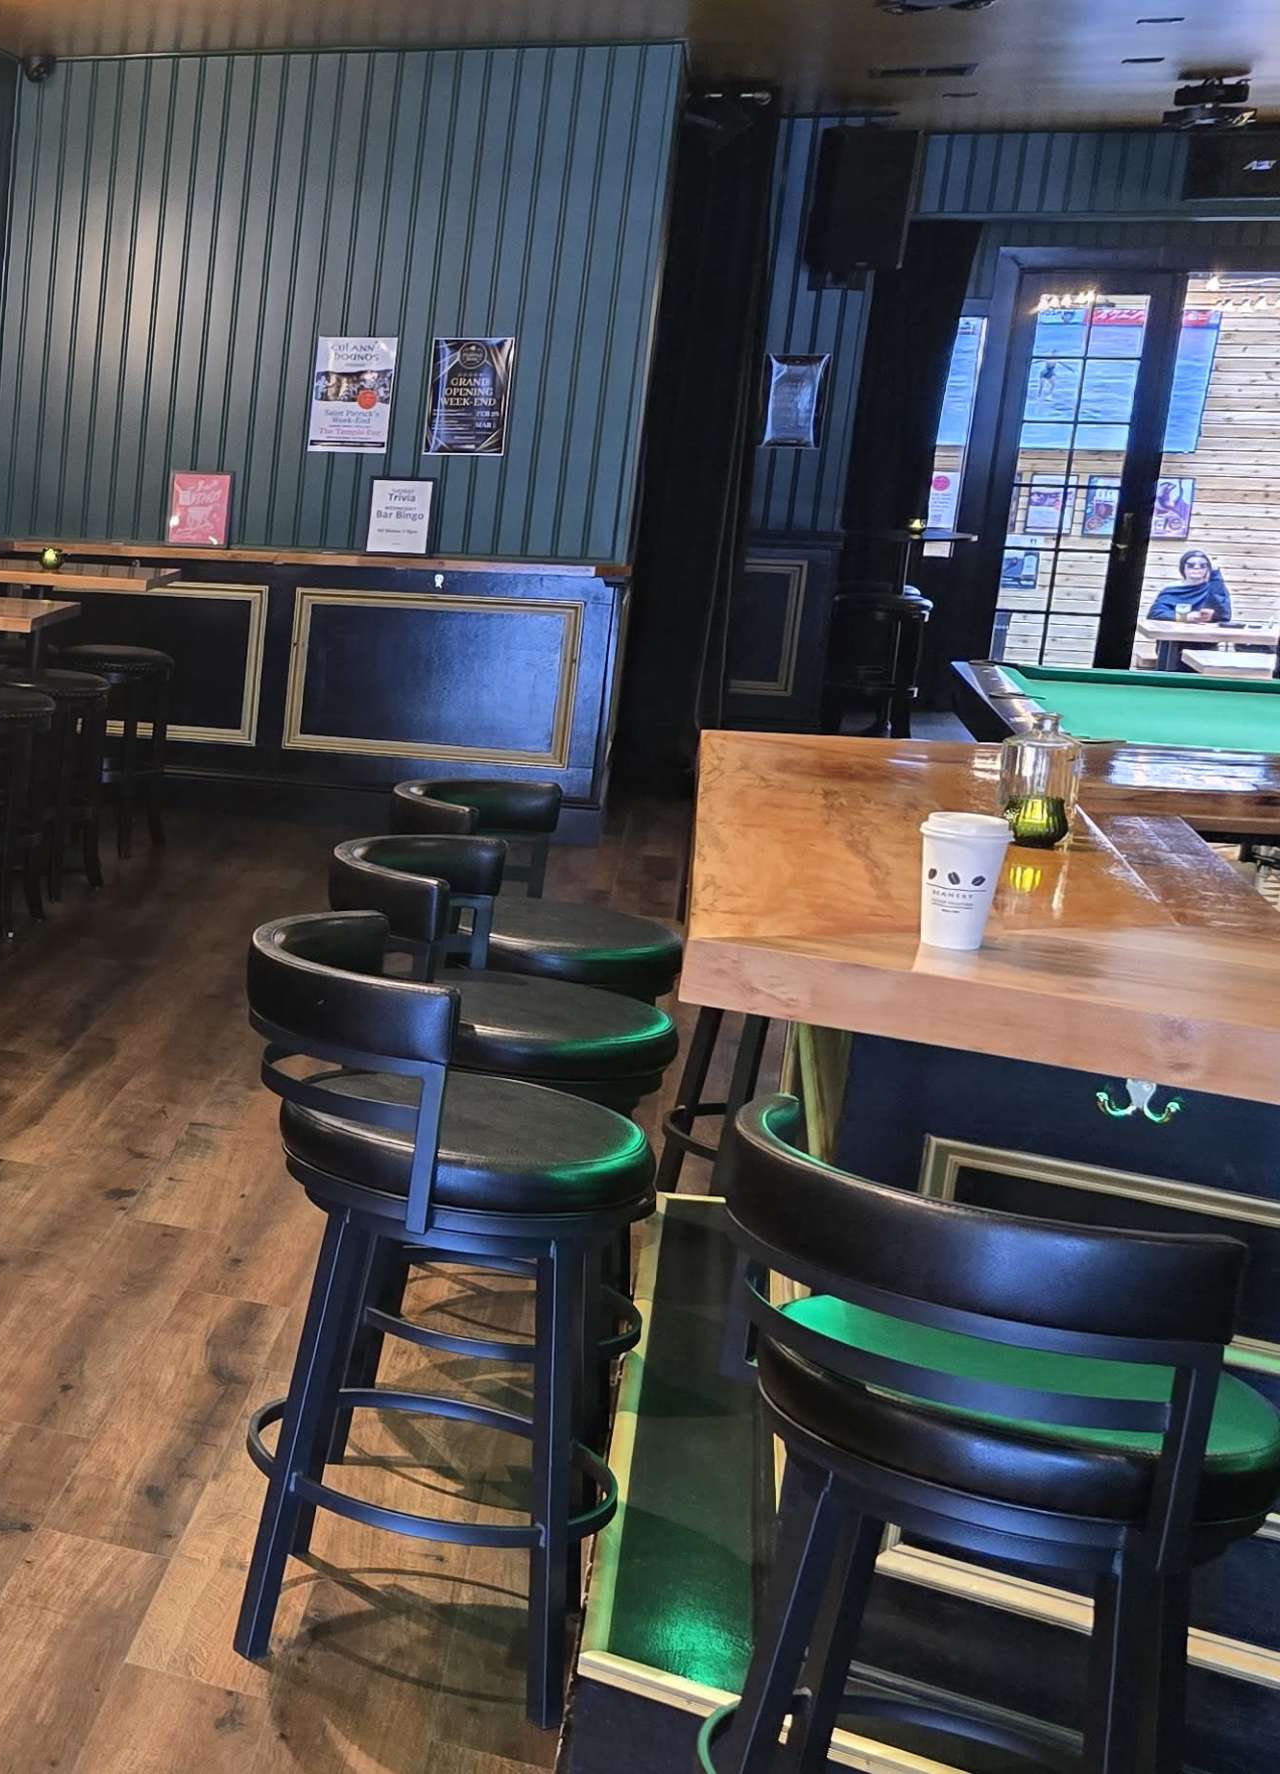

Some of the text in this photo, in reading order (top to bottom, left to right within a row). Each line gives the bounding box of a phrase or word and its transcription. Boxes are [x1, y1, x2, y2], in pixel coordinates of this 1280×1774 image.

[451, 377, 490, 387] GRAND
[444, 387, 494, 397] OPENING
[388, 493, 416, 502] Trivia
[376, 510, 424, 522] Bar Bingo
